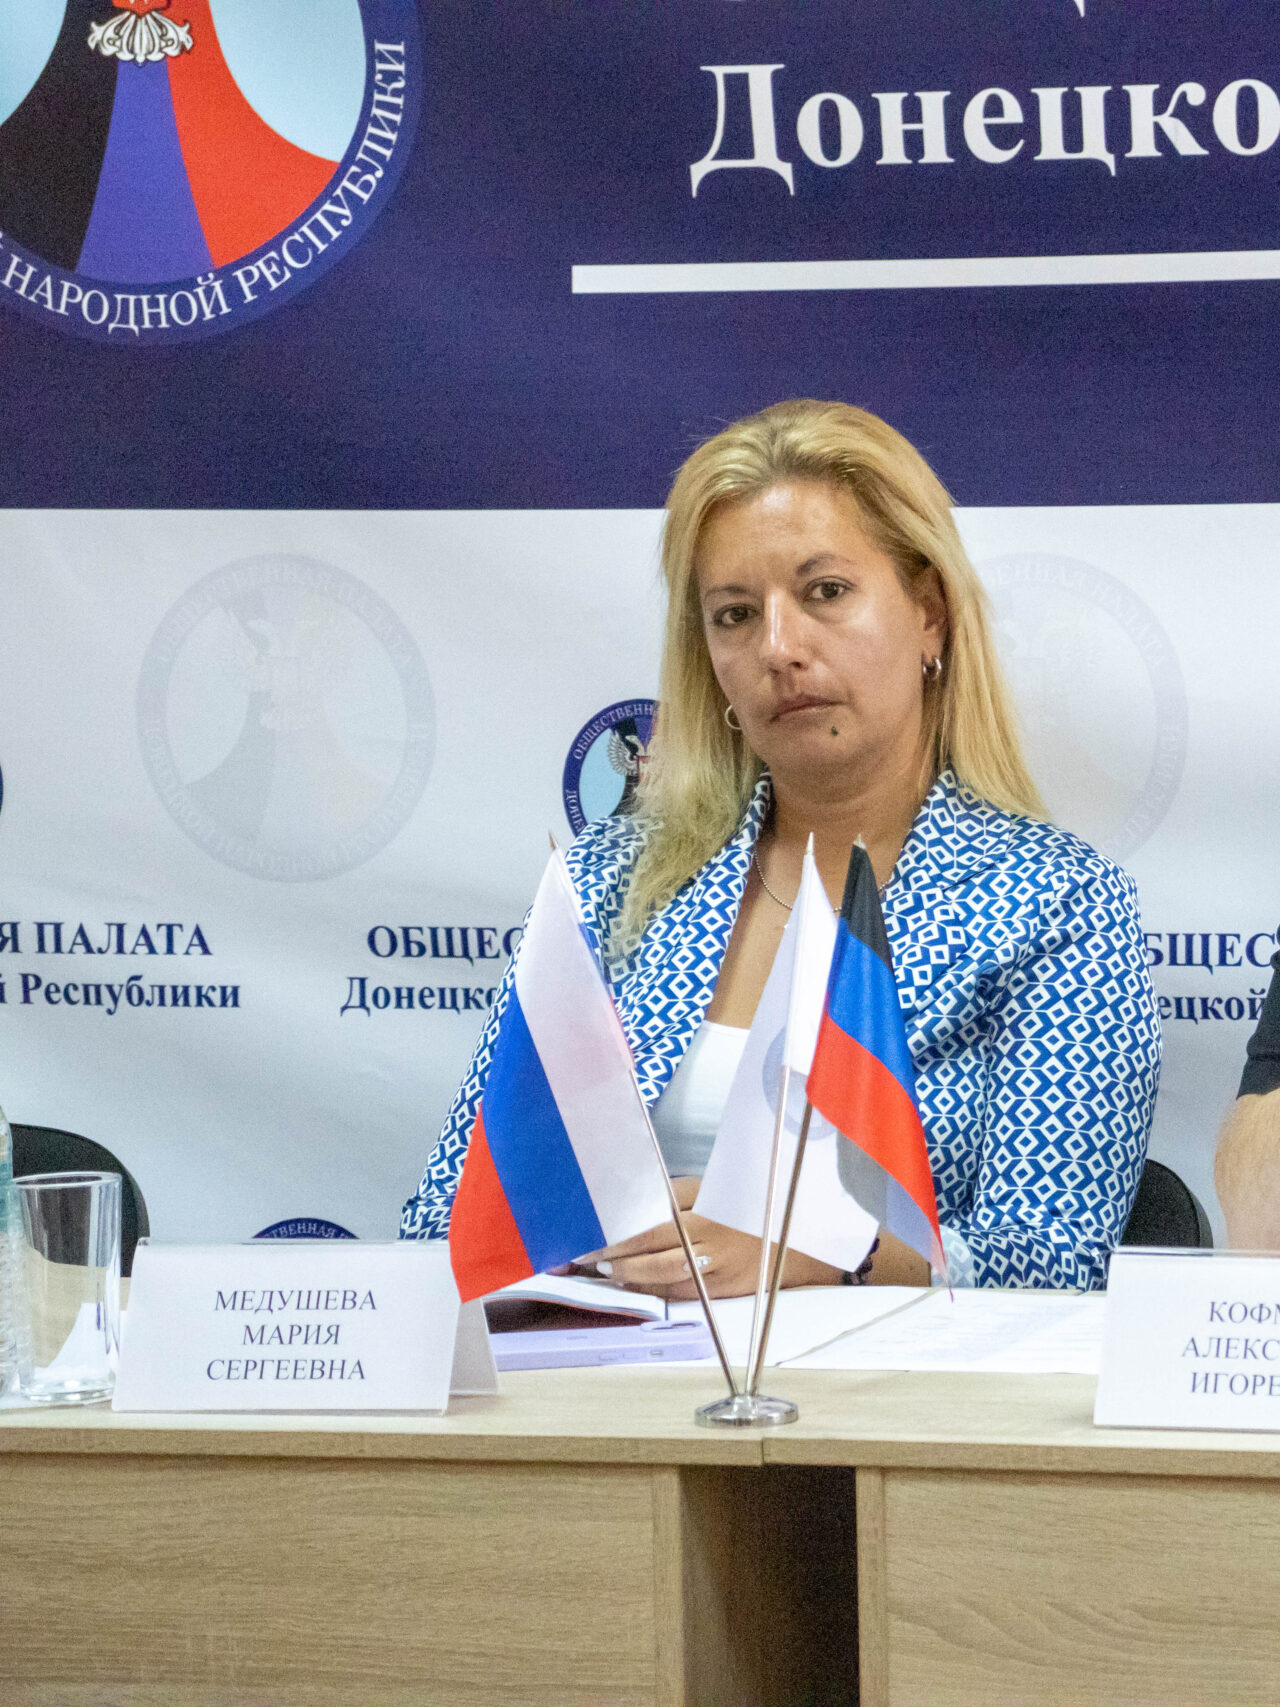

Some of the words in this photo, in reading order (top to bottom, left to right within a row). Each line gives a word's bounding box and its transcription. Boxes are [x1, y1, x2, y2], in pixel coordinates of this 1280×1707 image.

[0, 253, 229, 337] НАРОДНОЙ
[234, 40, 406, 303] РЕСПУБЛИКИ
[34, 922, 213, 956] ПАЛАТА
[19, 973, 241, 1016] Республики
[214, 1289, 377, 1314] МЕДУШЕВА
[242, 1324, 340, 1346] МАРИЯ
[206, 1359, 366, 1381] СЕРГЕЕВНА
